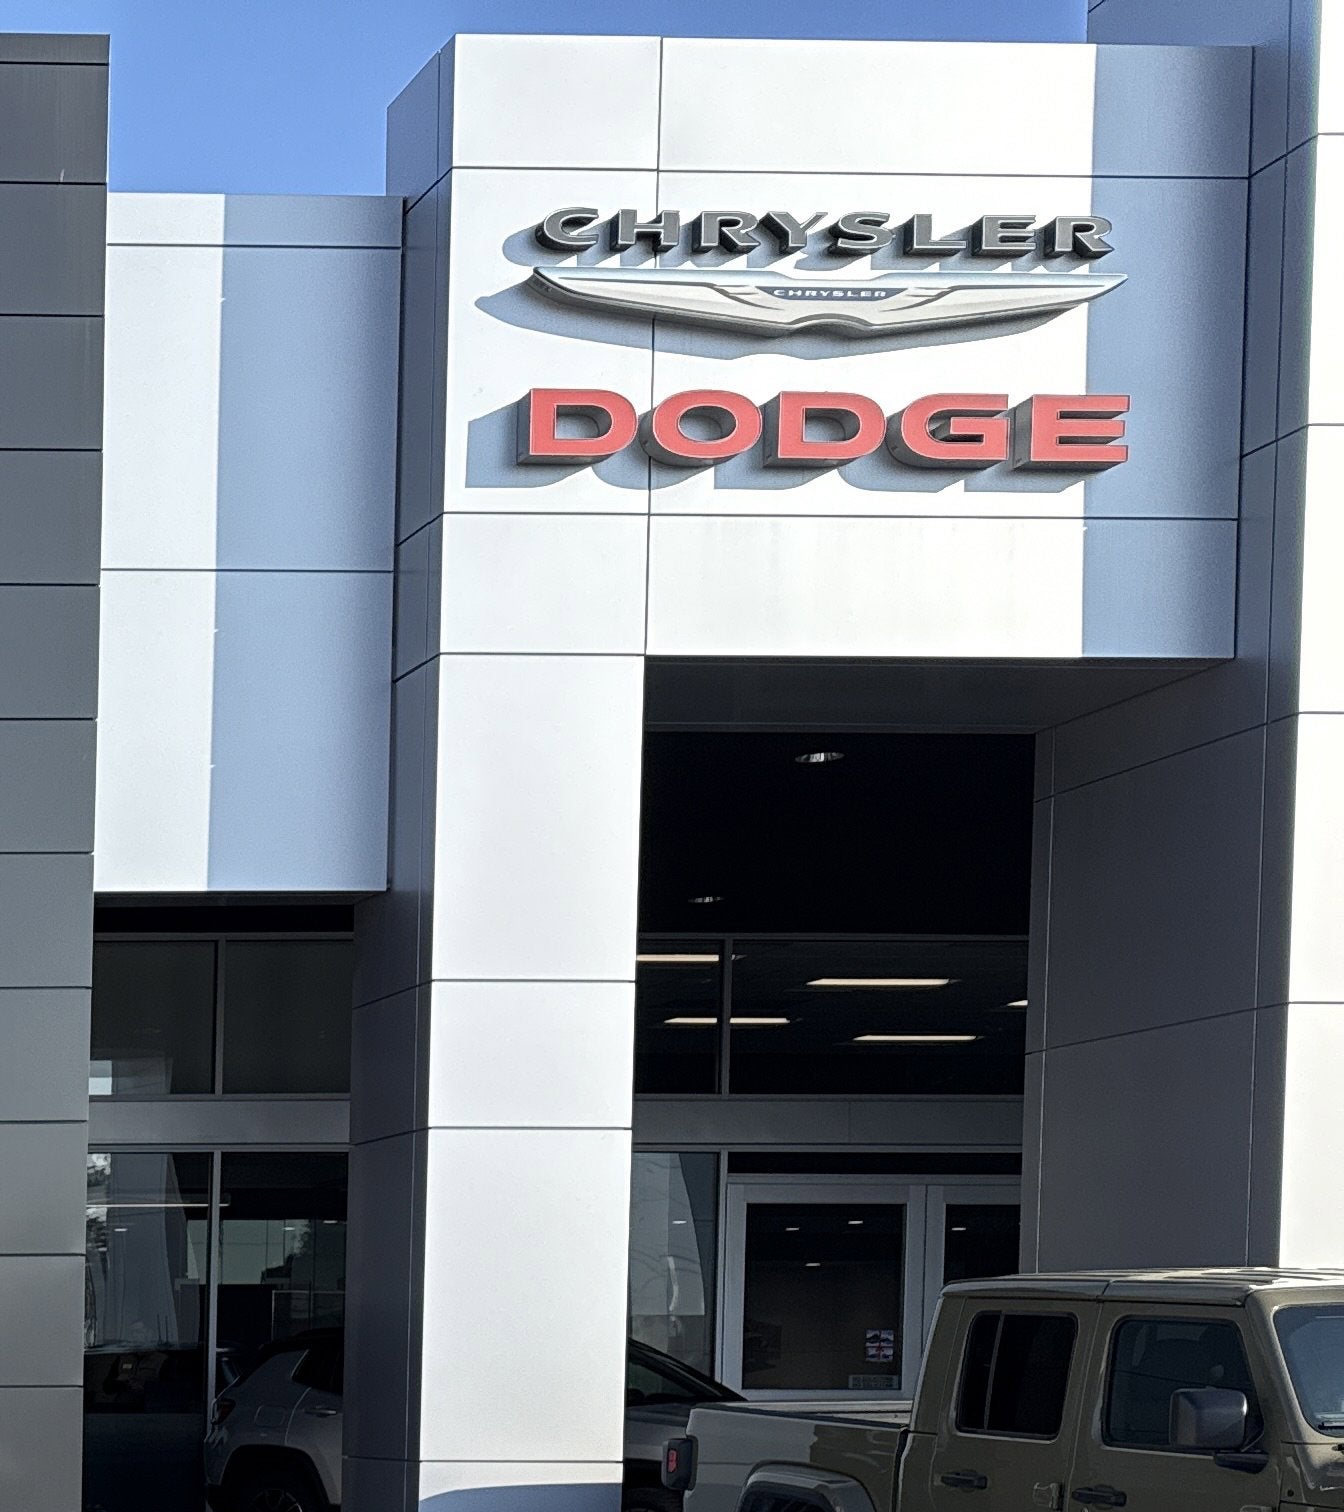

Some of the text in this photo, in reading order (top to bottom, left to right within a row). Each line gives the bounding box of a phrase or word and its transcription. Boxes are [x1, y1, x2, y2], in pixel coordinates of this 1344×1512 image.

[537, 206, 1115, 257] CHRYSLER
[773, 289, 887, 298] CHRYSLER
[525, 387, 1131, 464] DODGE
